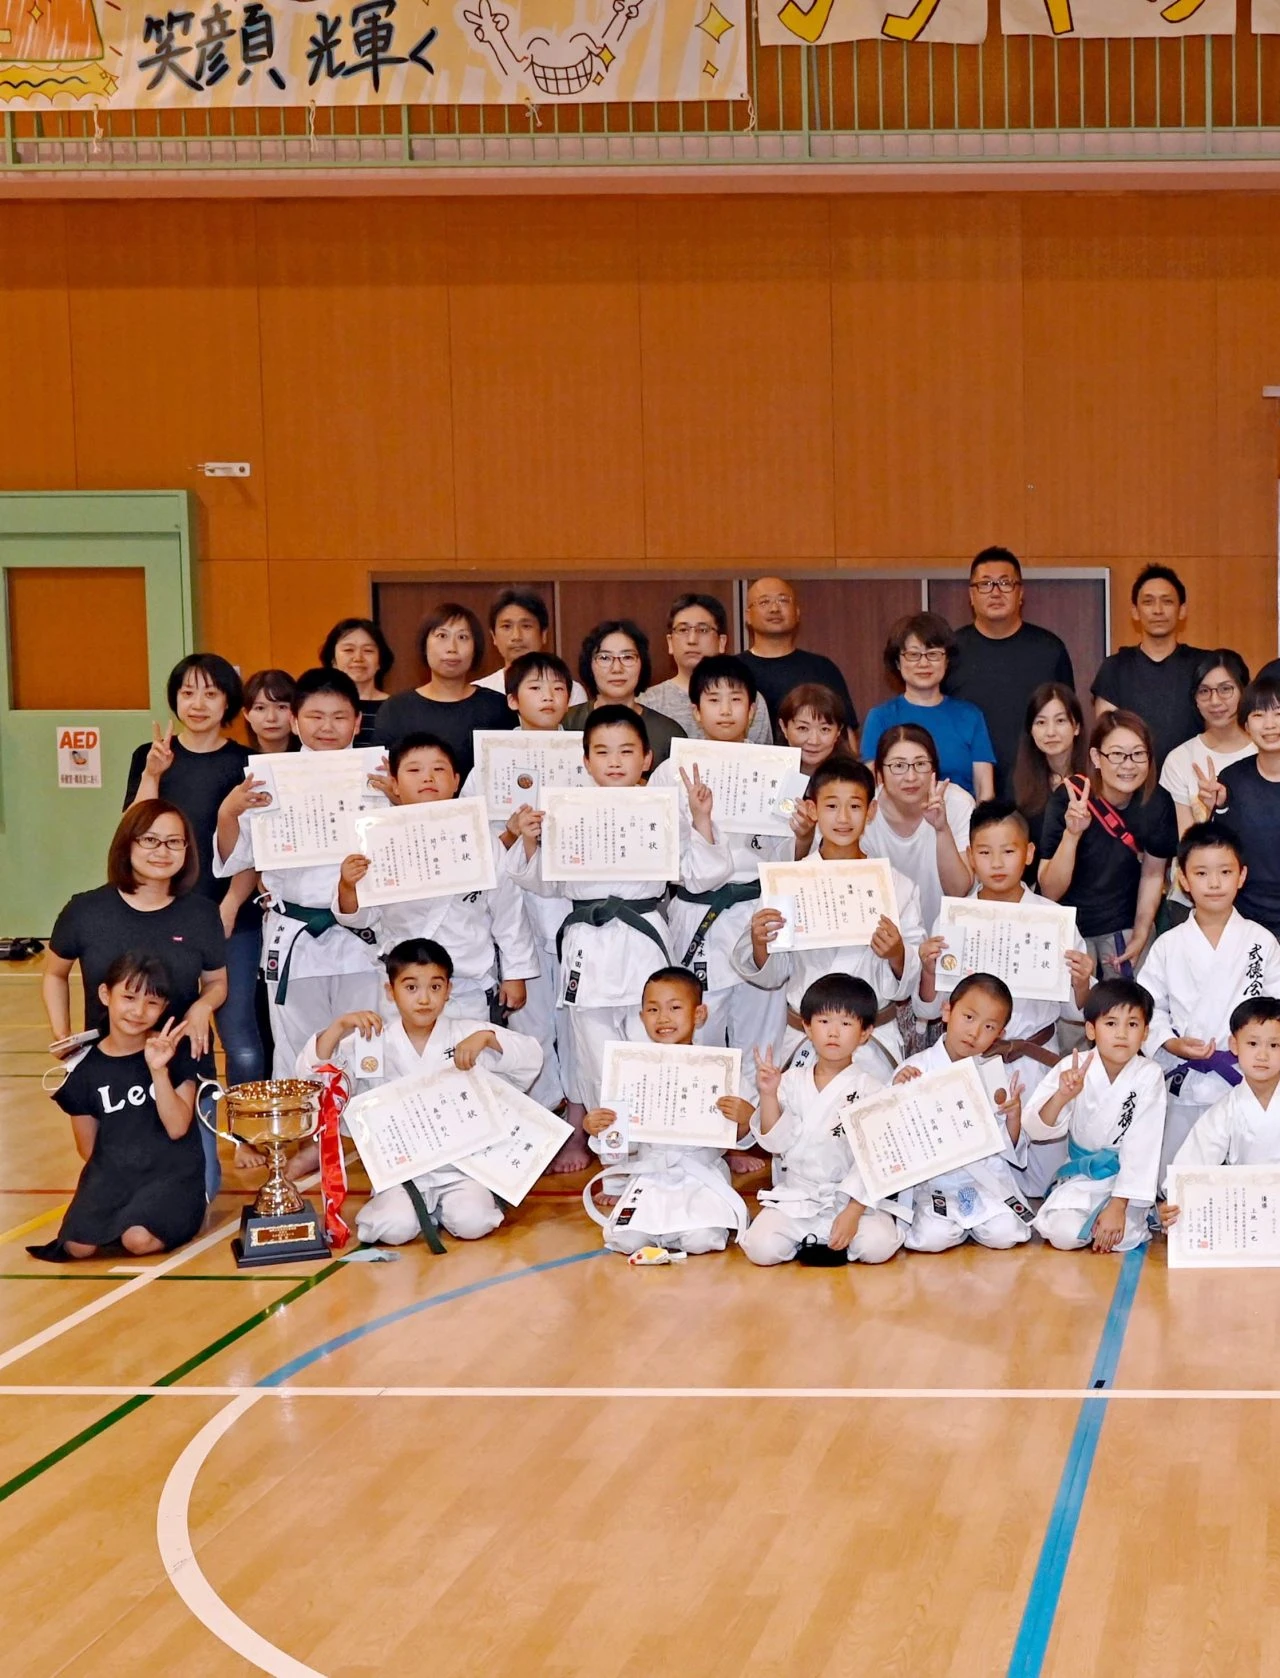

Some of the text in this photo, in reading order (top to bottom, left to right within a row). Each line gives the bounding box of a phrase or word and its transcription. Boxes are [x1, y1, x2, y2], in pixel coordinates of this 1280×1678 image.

[138, 3, 436, 93] 笑顔 輝く
[59, 731, 98, 749] AED
[768, 779, 779, 807] 賞状
[459, 833, 472, 862] 賞状
[648, 822, 659, 851] 賞状
[866, 889, 878, 916] 賞状
[1040, 941, 1053, 970] 賞状
[459, 1090, 479, 1121] 賞状
[708, 1084, 719, 1115] 賞状
[955, 1099, 975, 1130] 賞状
